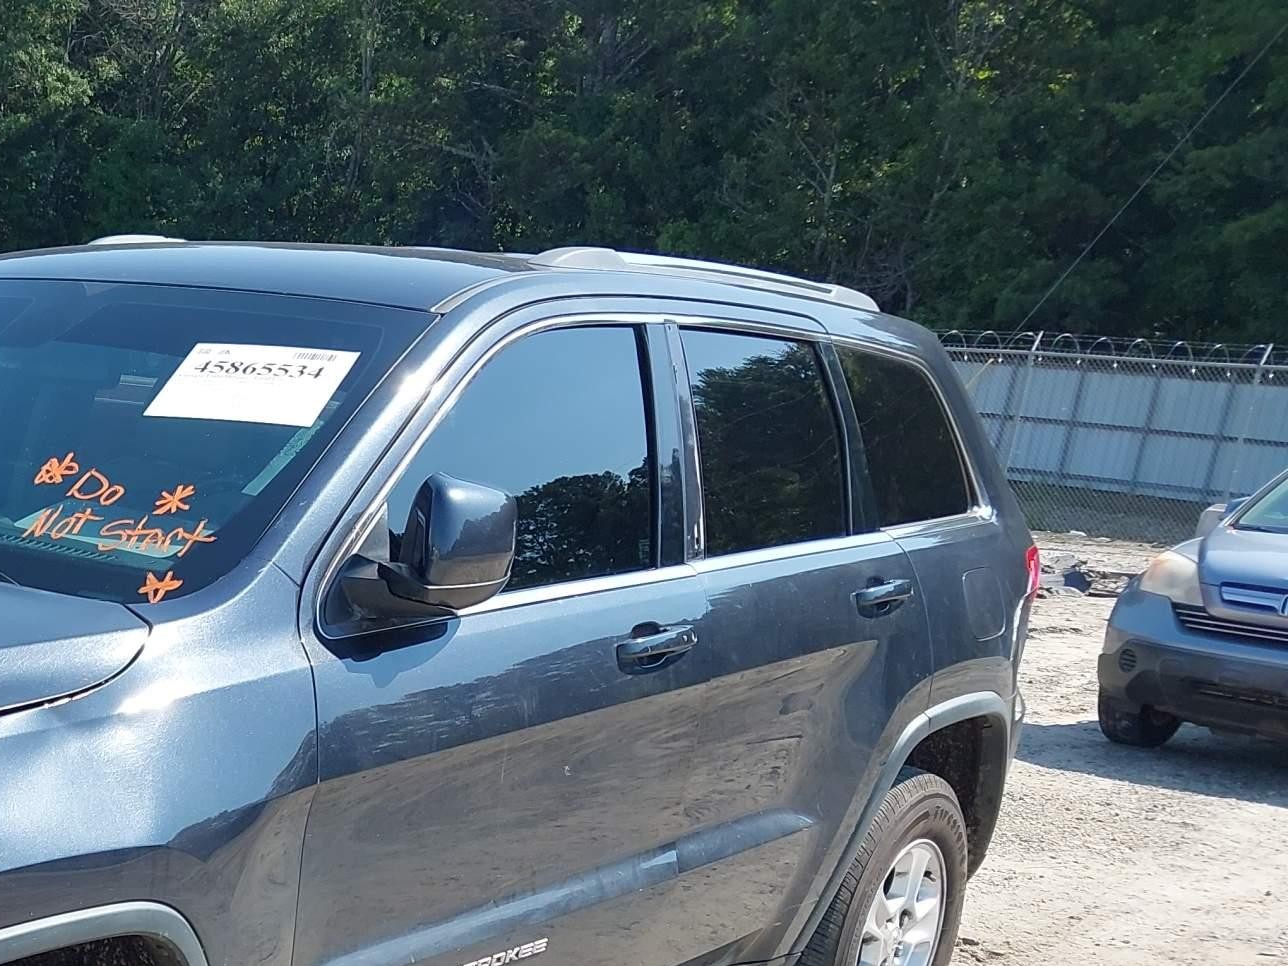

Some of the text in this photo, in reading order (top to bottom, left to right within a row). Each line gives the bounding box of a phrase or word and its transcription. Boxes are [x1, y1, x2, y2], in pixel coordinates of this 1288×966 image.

[194, 359, 326, 381] 45865534
[66, 468, 125, 506] Do
[22, 504, 217, 557] Not Start
